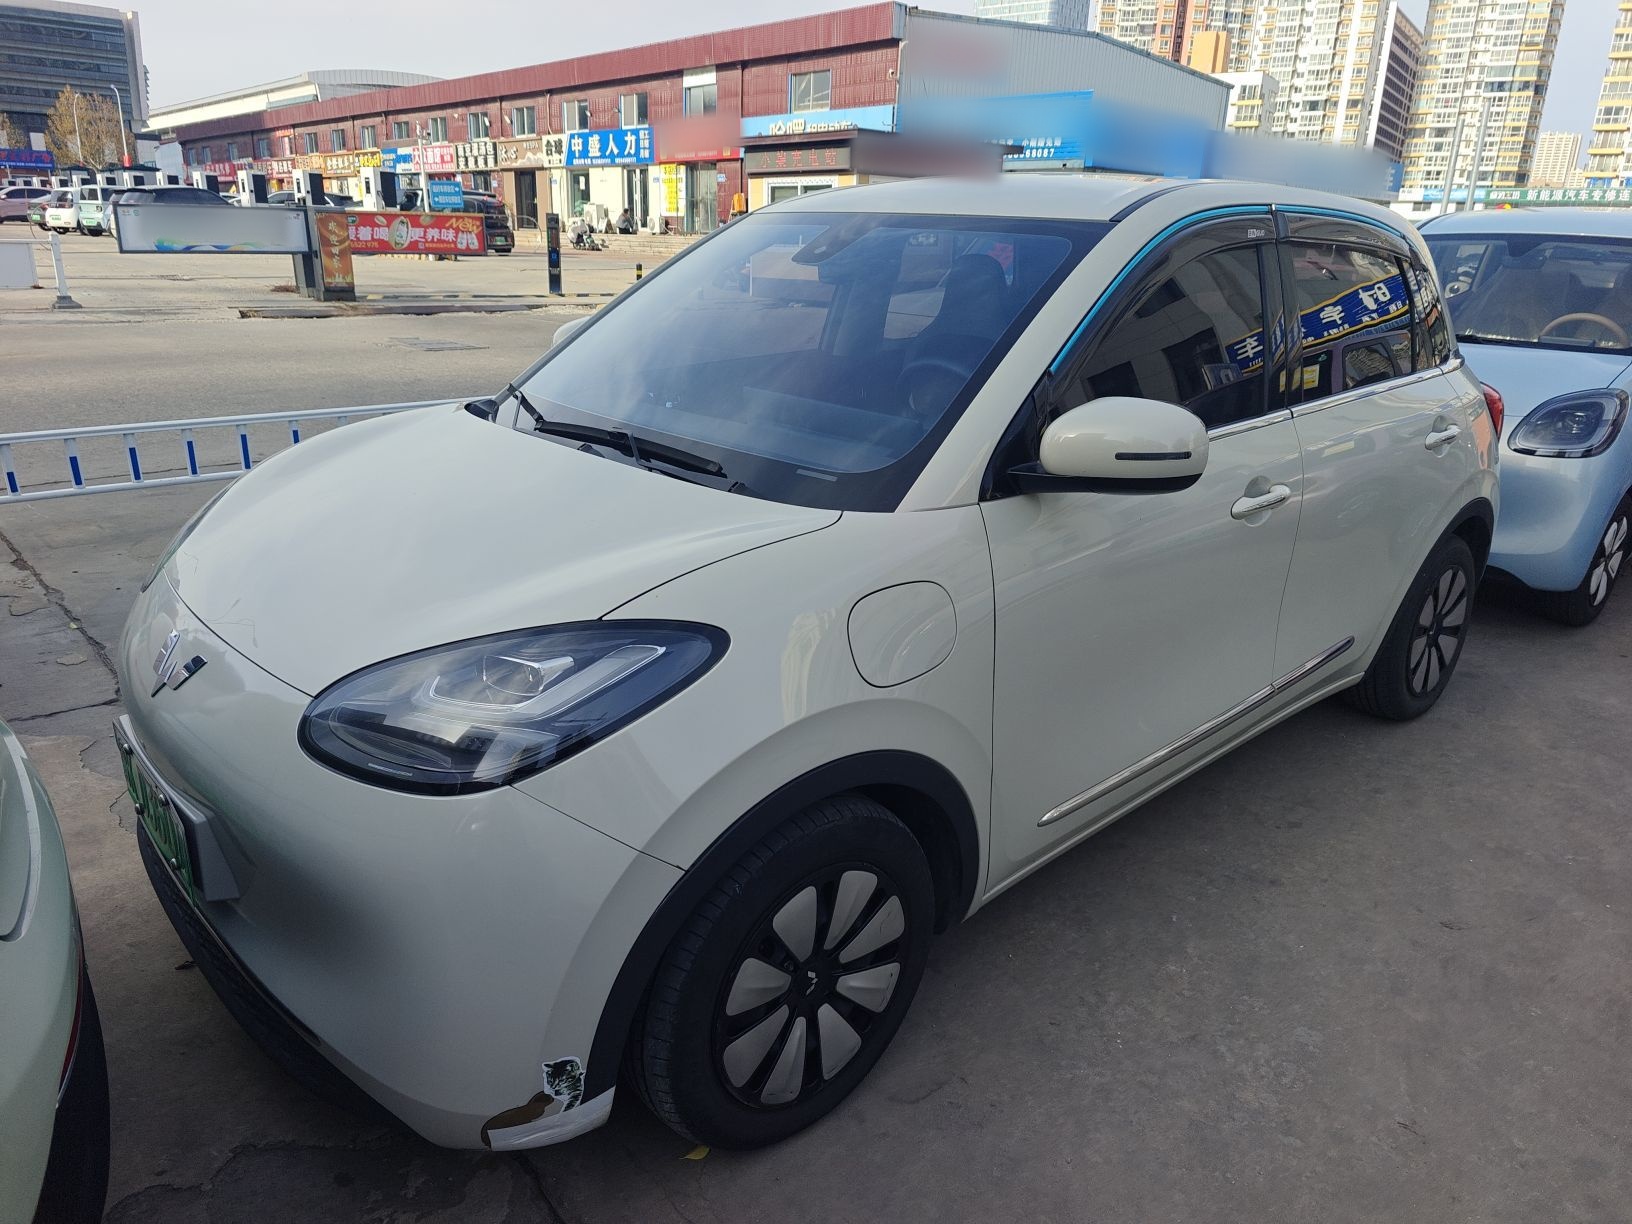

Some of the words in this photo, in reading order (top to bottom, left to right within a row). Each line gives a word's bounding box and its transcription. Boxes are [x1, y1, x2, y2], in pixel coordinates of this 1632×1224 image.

[571, 131, 637, 158] 中盛人力
[412, 147, 441, 164] 大面馆
[1526, 189, 1631, 202] 新能源汽车专修连
[409, 228, 457, 243] 更养味
